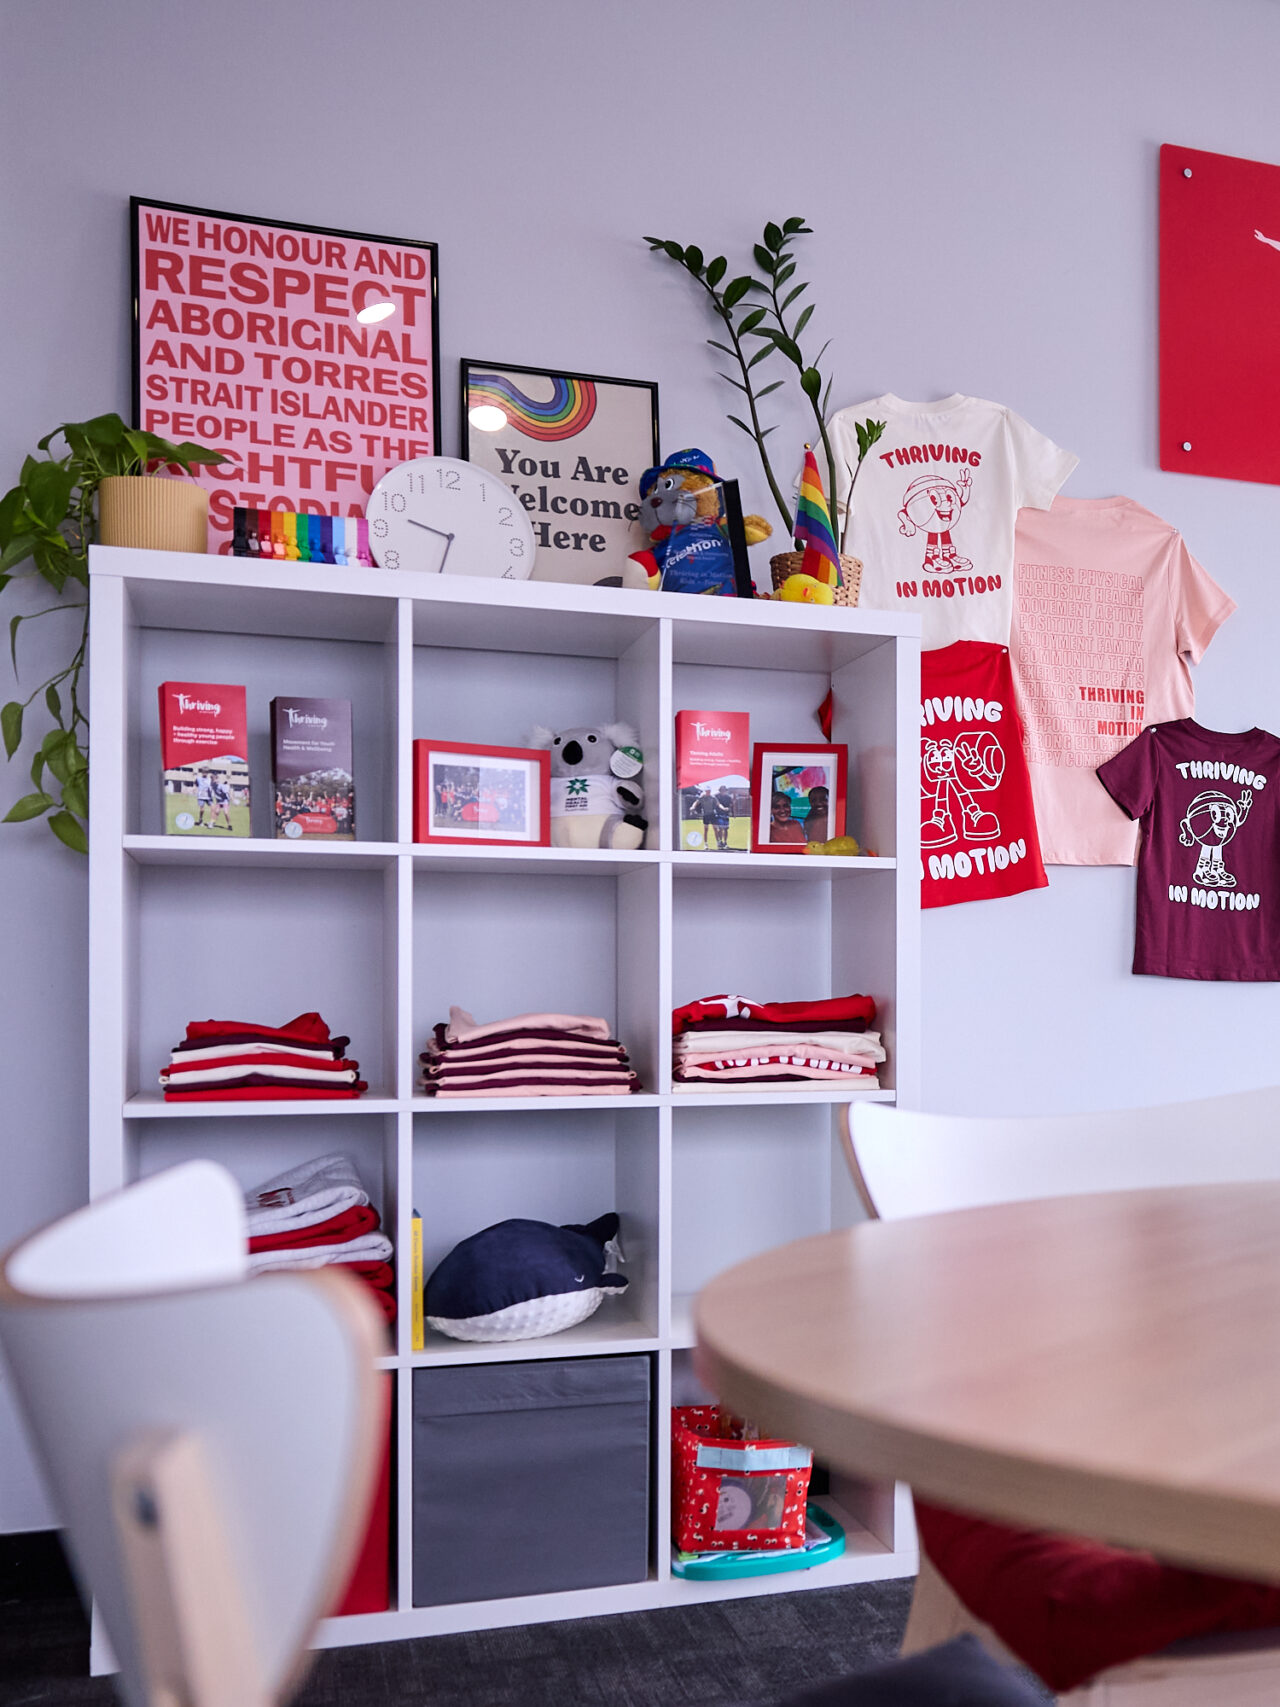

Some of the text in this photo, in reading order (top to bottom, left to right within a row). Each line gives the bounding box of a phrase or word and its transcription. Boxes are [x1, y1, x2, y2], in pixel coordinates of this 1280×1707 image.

[145, 213, 426, 281] WE HONOUR AND
[145, 248, 427, 327] RESPECT
[146, 299, 428, 366] ABORIGINAL
[146, 339, 428, 399] AND TORRES
[146, 374, 428, 433] STRAIT ISLANDER
[146, 408, 428, 460] PEOPLE AS THE
[495, 447, 629, 485] You Are
[879, 443, 982, 469] THRIVING
[407, 472, 424, 494] 11
[436, 468, 461, 491] 12
[382, 491, 406, 513] 10
[511, 485, 642, 521] elcome
[373, 518, 389, 538] 9
[498, 506, 514, 527] 2
[384, 550, 400, 570] 8
[509, 537, 525, 558] 3
[896, 574, 1002, 598] IN MOTION
[1018, 563, 1144, 591] FITNESS PHYSICAL
[1018, 581, 1144, 607] INCLUSIVE HEALTH
[1019, 598, 1144, 624] MOVEMENT ACTIVE
[1019, 613, 1144, 640] POSITIVE FUN JOY
[1020, 630, 1144, 657] ENJOYMENT FAMILY
[1018, 646, 1144, 672] COMMUNITY TEAM
[1019, 663, 1144, 688] EXERCISE EXPERTS
[172, 693, 221, 716] Thriving
[1019, 680, 1145, 704] FRIENDS THRIVING
[282, 708, 327, 729] Thriving
[1019, 697, 1145, 721] MENTAL HEALTH IN
[689, 722, 731, 742] Thriving
[1096, 720, 1143, 737] MOTION
[1175, 760, 1267, 791] THRIVING
[928, 838, 1027, 881] MOTION
[1168, 885, 1260, 911] IN MOTION
